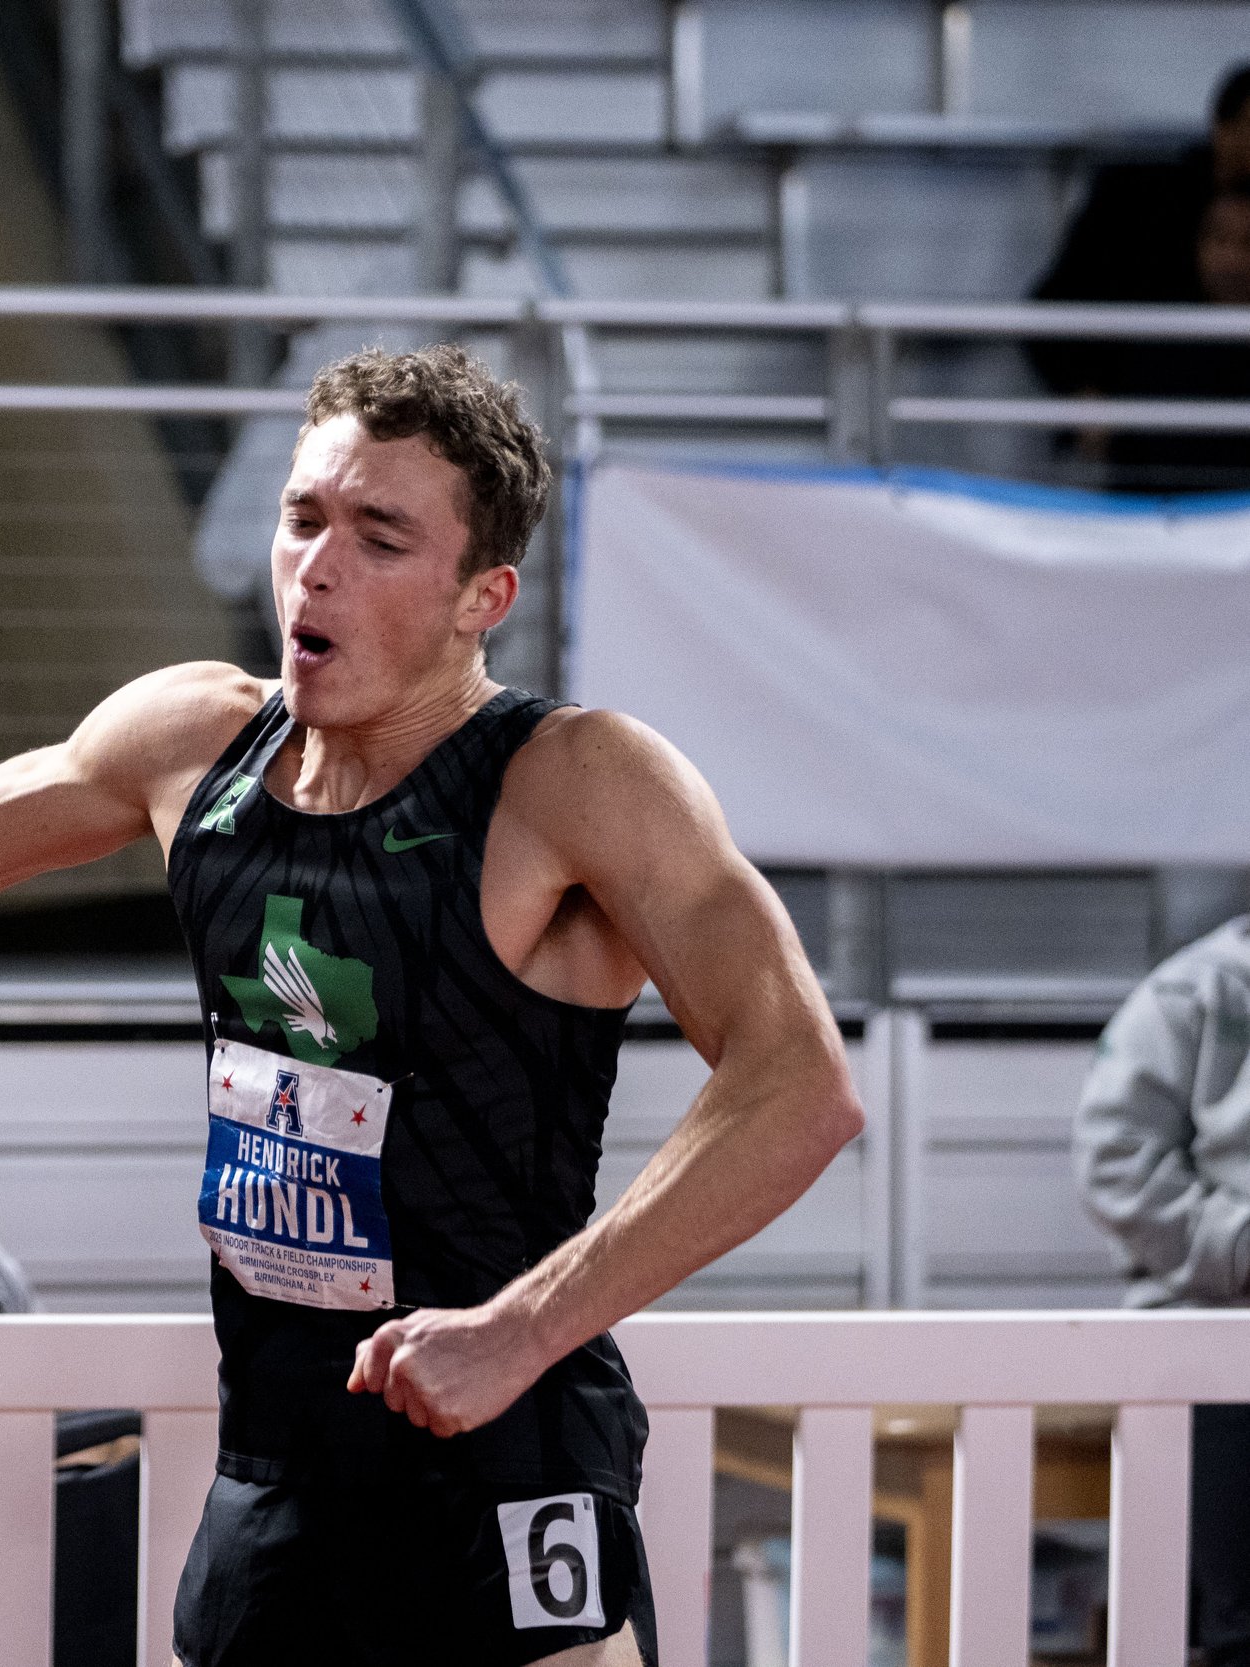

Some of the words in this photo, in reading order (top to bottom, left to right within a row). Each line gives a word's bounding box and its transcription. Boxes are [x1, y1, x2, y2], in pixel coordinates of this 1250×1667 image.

[237, 1130, 341, 1188] HENDRICK
[216, 1162, 369, 1249] HUNDL
[223, 1234, 249, 1251] INDOOR
[251, 1241, 275, 1258] TRACK
[276, 1248, 282, 1259] &
[283, 1250, 305, 1264] FIELD
[306, 1254, 377, 1274] CHAMPIONSHIPS
[239, 1255, 286, 1273] BIRMINGHAM
[287, 1266, 335, 1282] CROSSPLEX
[254, 1272, 306, 1291] BIRMINGHAM,
[307, 1283, 318, 1293] AL
[528, 1502, 587, 1618] 6
